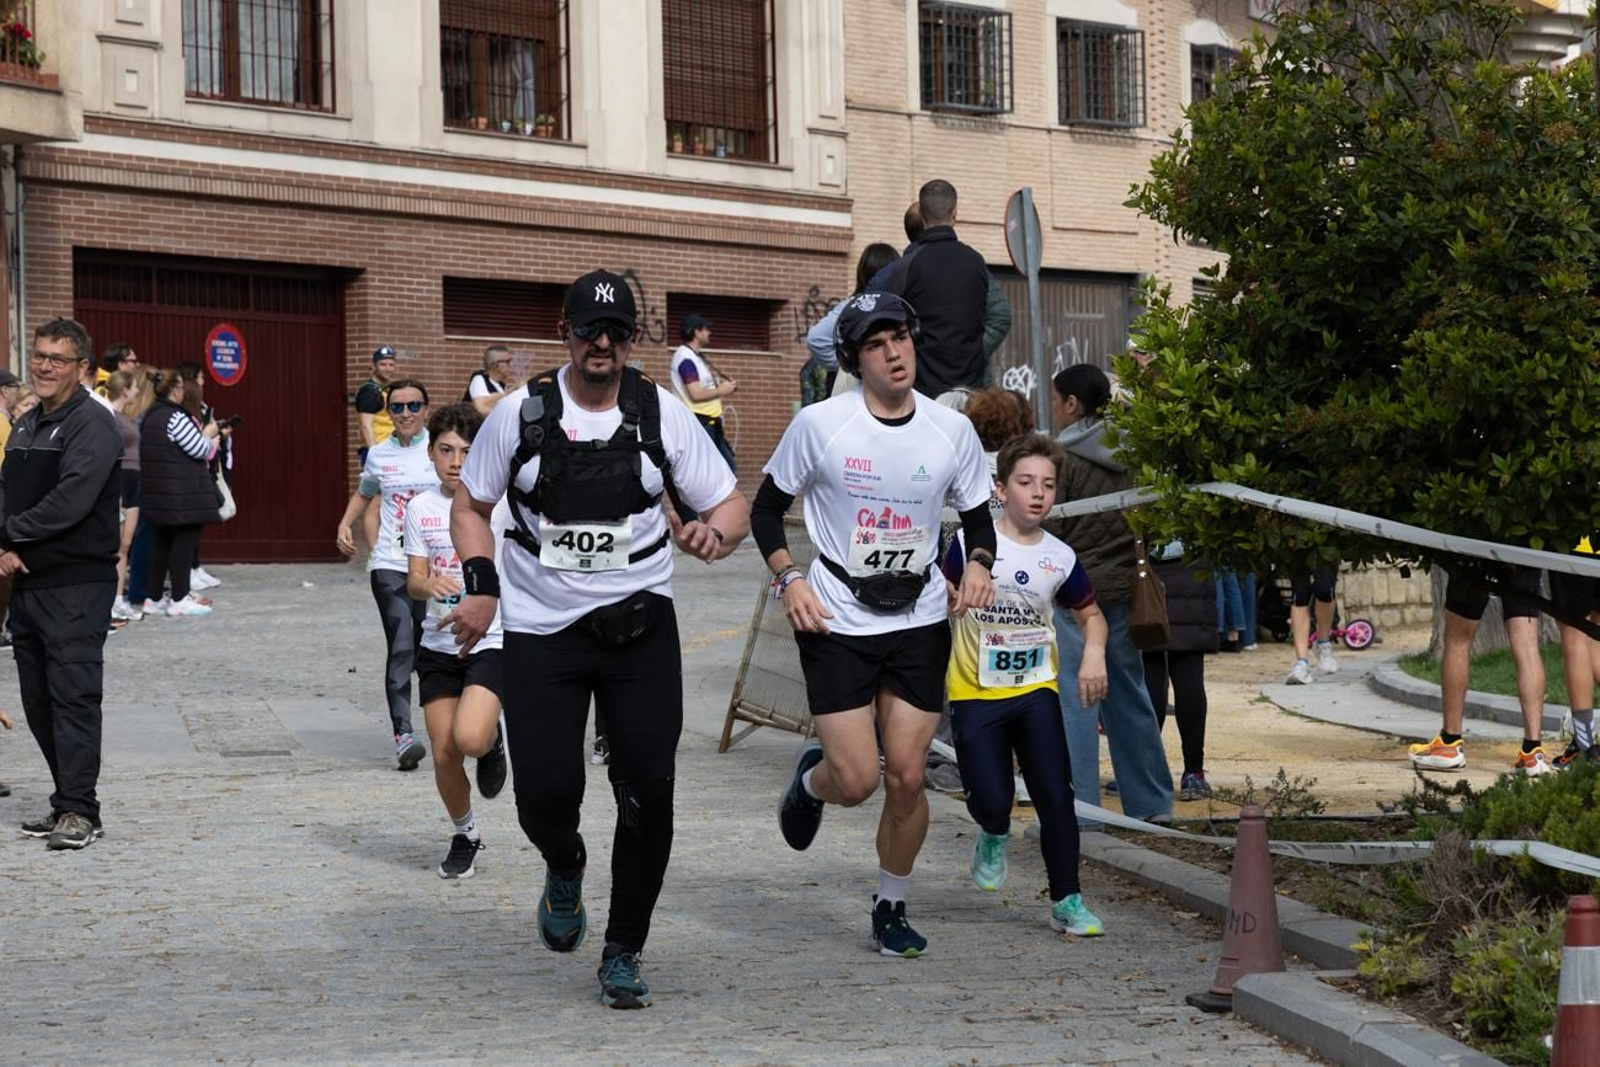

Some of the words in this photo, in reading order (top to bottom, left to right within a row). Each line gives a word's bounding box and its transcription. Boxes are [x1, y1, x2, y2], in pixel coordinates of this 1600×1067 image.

[844, 457, 872, 472] XXVII
[420, 517, 442, 528] XXVII
[558, 530, 614, 553] 402
[864, 549, 915, 569] 477
[995, 648, 1039, 671] 851
